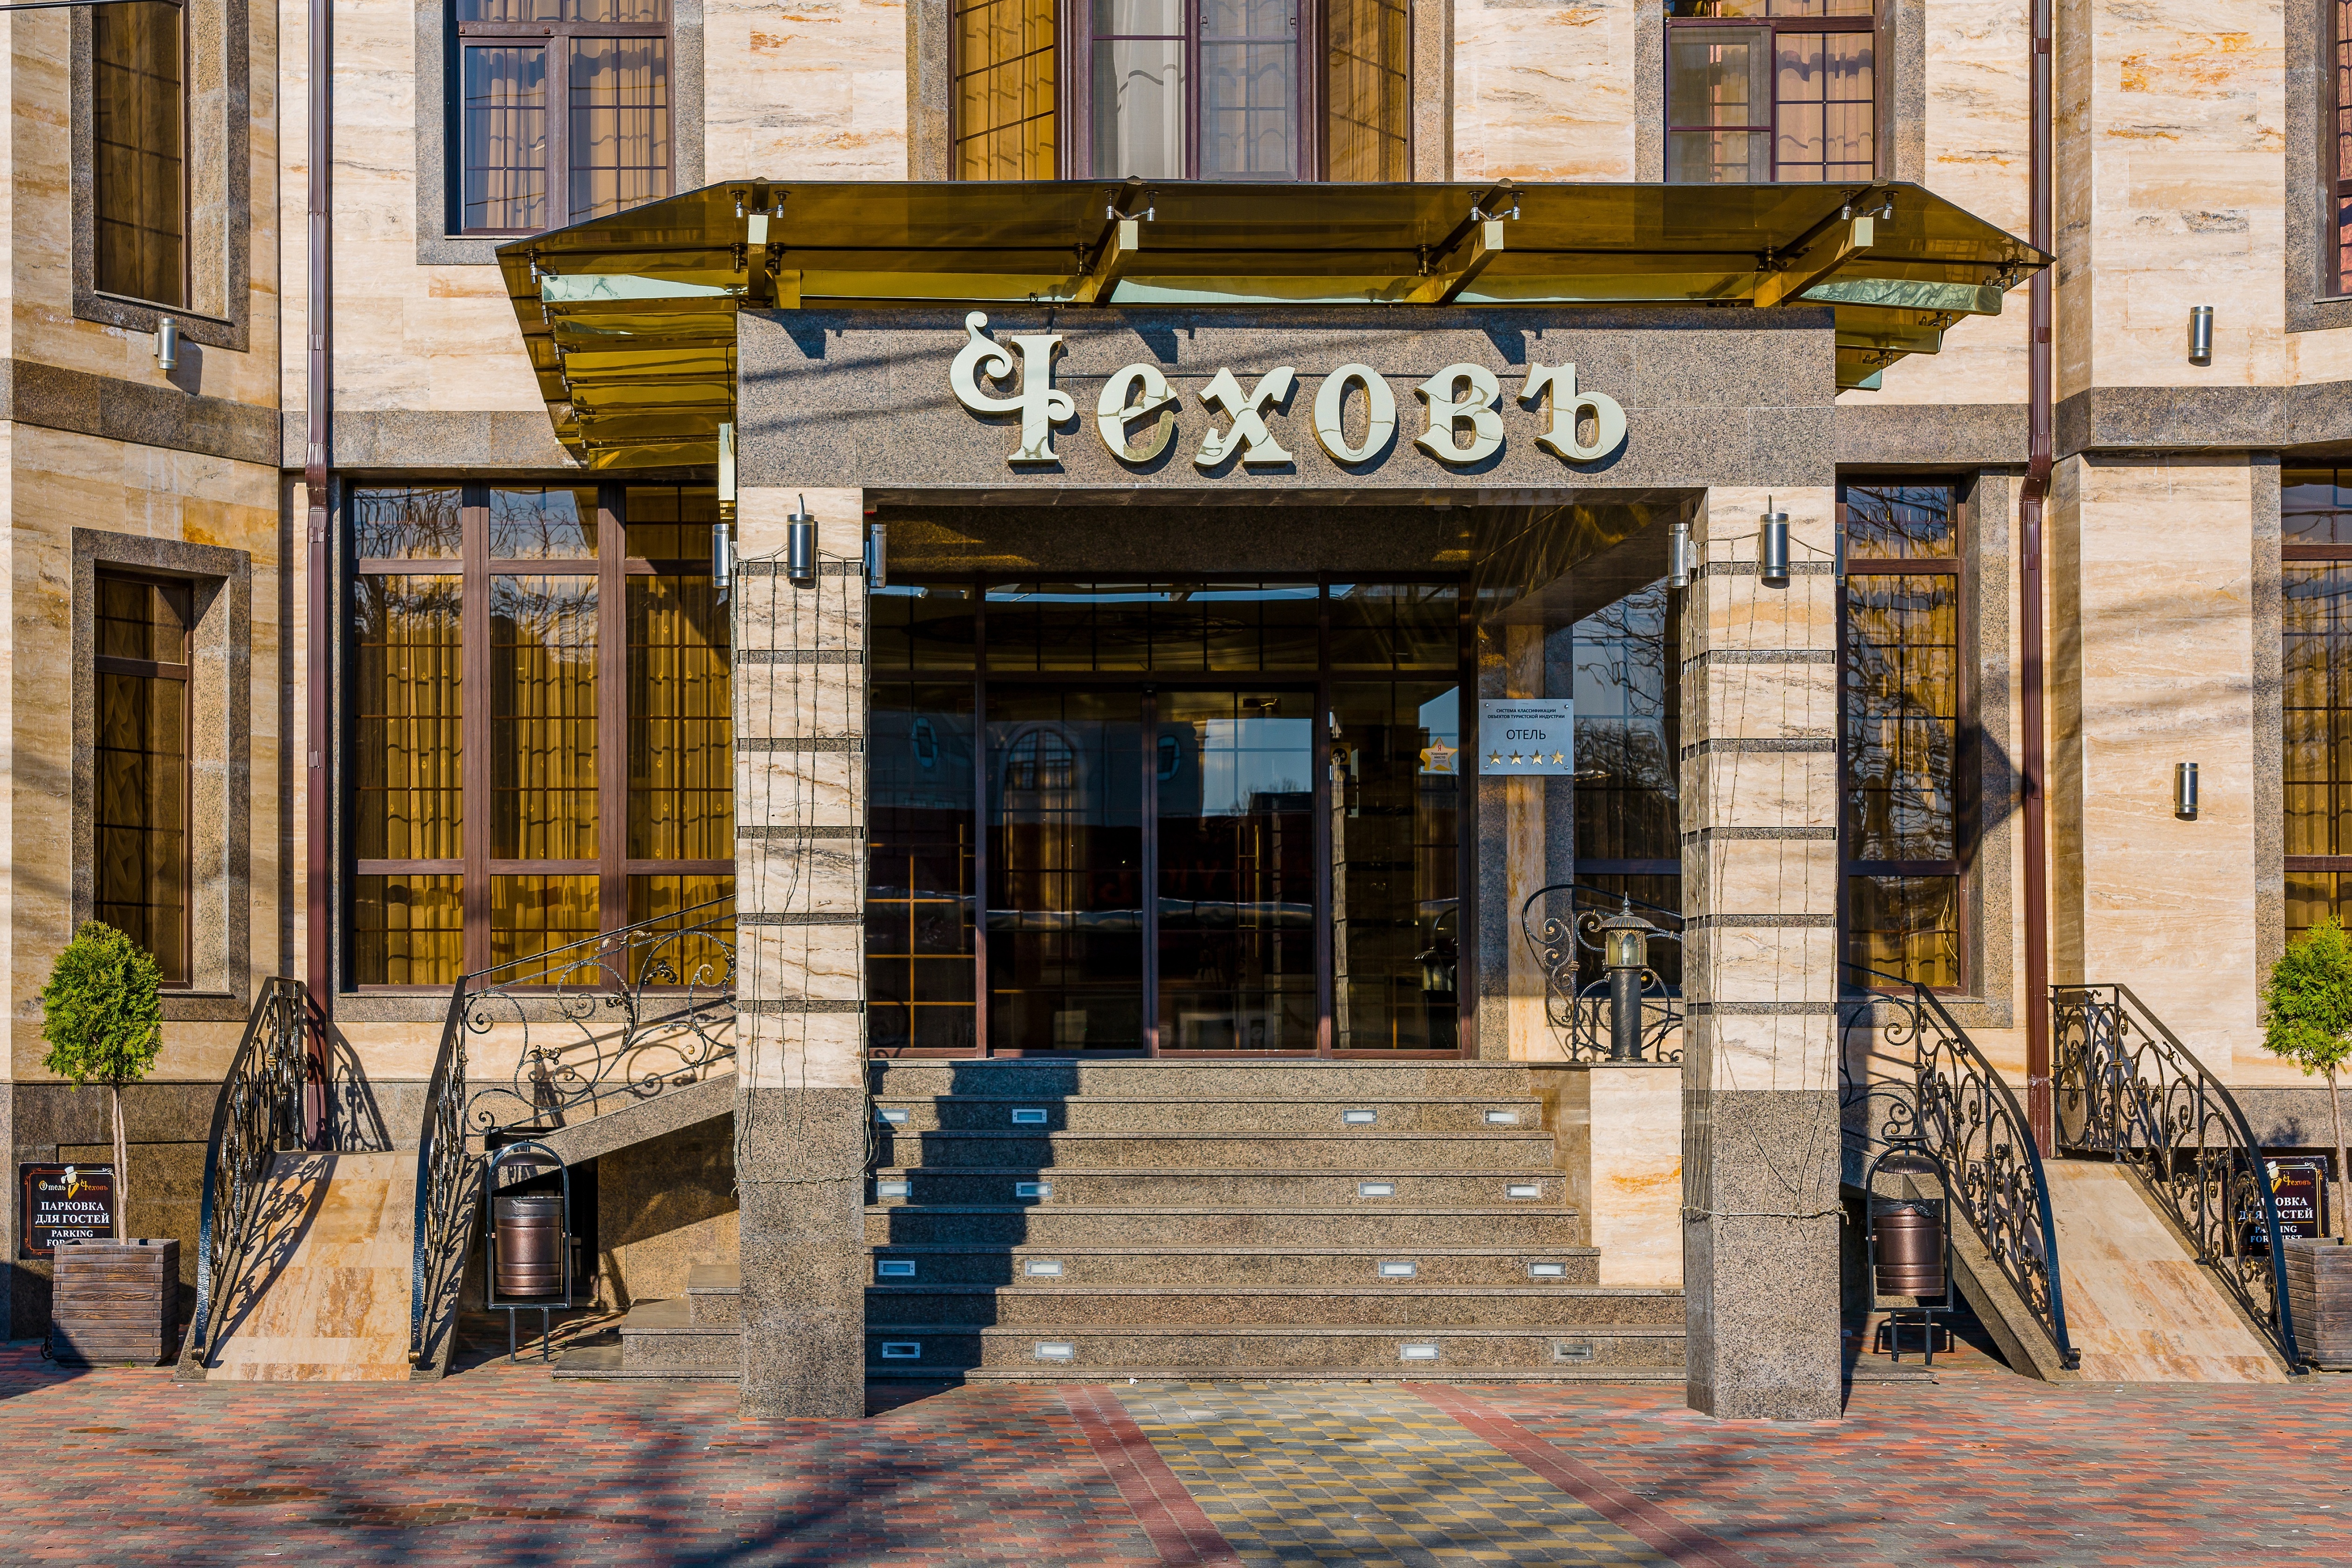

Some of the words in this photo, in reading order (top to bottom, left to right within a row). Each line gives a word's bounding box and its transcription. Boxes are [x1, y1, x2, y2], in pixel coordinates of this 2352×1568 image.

[949, 311, 1627, 465] Чеховъ
[1506, 729, 1547, 740] ОТЕЛЬ
[39, 1180, 66, 1191] Отель
[80, 1179, 108, 1191] Чеховъ
[2283, 1174, 2311, 1186] Чеховъ
[41, 1201, 104, 1211] ПАРКОВКА
[35, 1214, 60, 1225] ДЛЯ
[62, 1213, 110, 1224] ГОСТЕЙ
[2238, 1210, 2263, 1222] ДЯ
